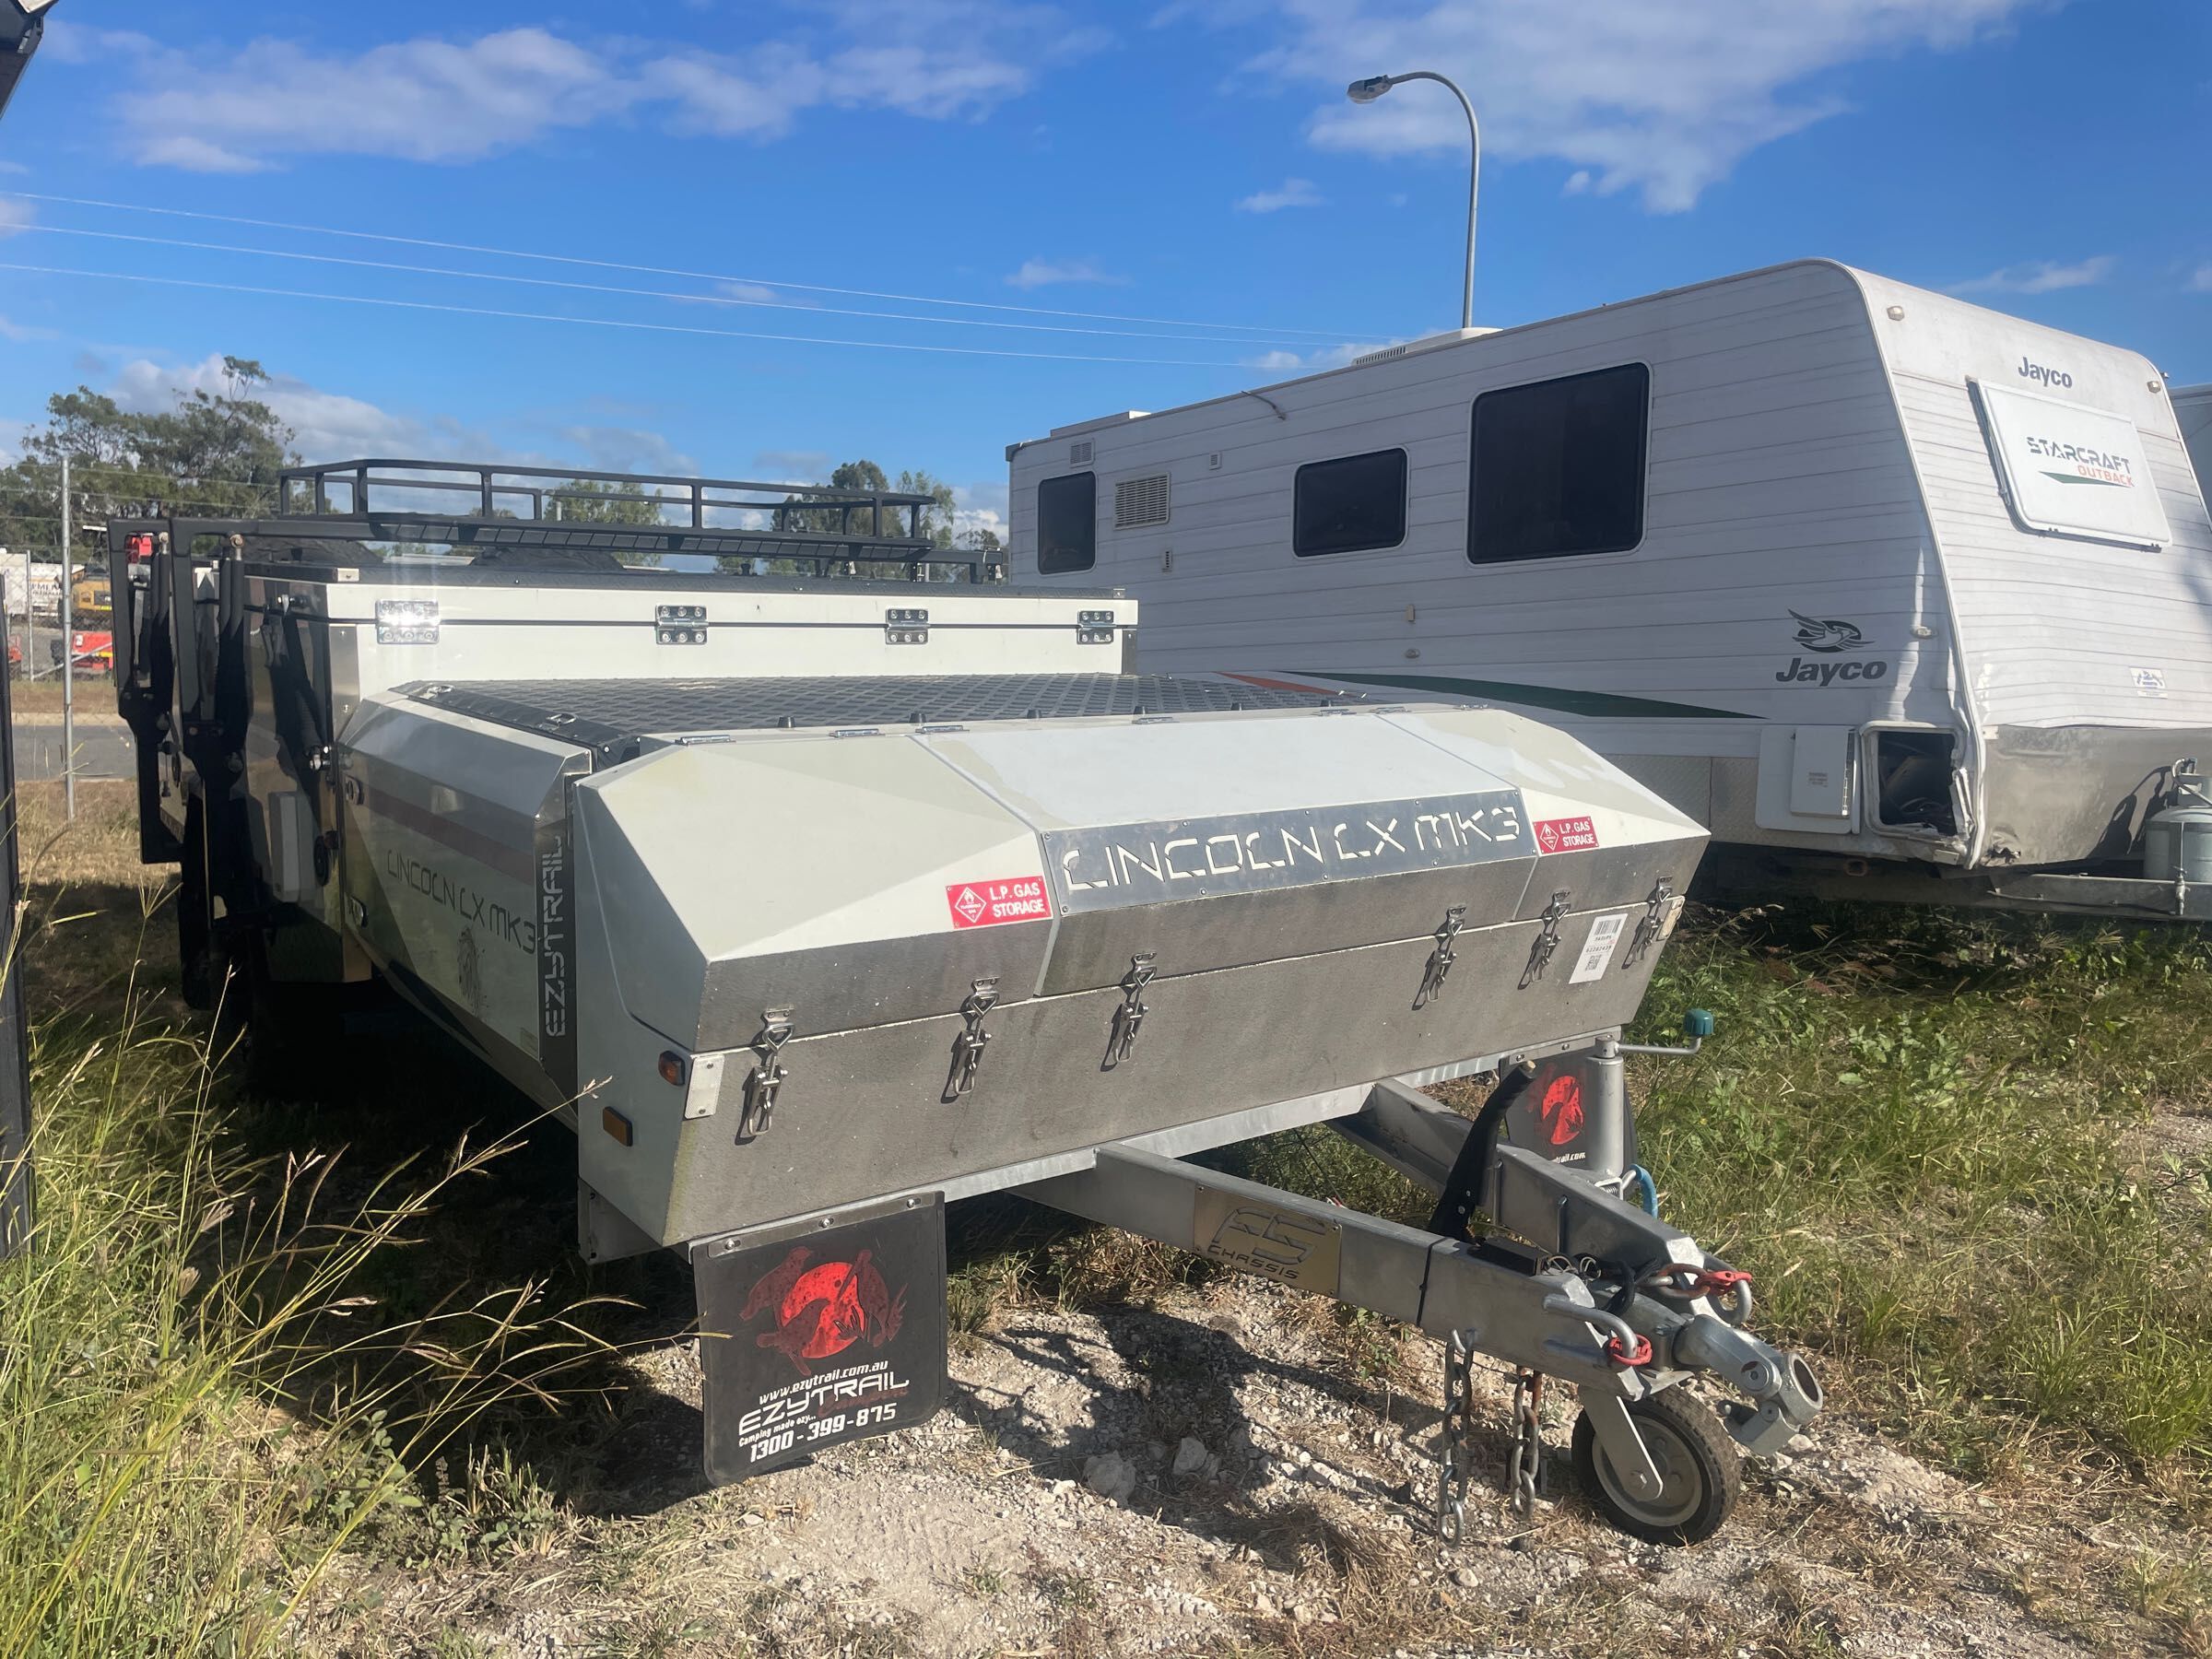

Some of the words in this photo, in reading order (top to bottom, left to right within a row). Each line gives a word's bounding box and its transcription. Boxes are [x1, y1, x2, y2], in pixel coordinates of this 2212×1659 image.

[2018, 356, 2073, 389] Jayco
[2026, 436, 2131, 475] STARCRAFT
[2077, 465, 2136, 488] OUTBACK
[1775, 657, 1888, 687] Jayco
[1562, 833, 1595, 847] STORAGE
[1573, 820, 1592, 833] GAS
[1063, 825, 1325, 891] LINCOLN
[1334, 817, 1406, 860] LX
[387, 849, 456, 912] LINCOLN
[459, 887, 486, 928] LX
[1013, 882, 1041, 899] GAS
[992, 900, 1046, 918] STORAGE
[541, 835, 567, 1038] EZYTRAIL
[1207, 1244, 1300, 1279] CHASSIS
[759, 1359, 889, 1406] www.ezytrail.com.au
[738, 1371, 911, 1437] EZYTRAIL
[738, 1428, 771, 1448] Camping
[773, 1418, 795, 1433] made
[796, 1414, 817, 1428] ezy...
